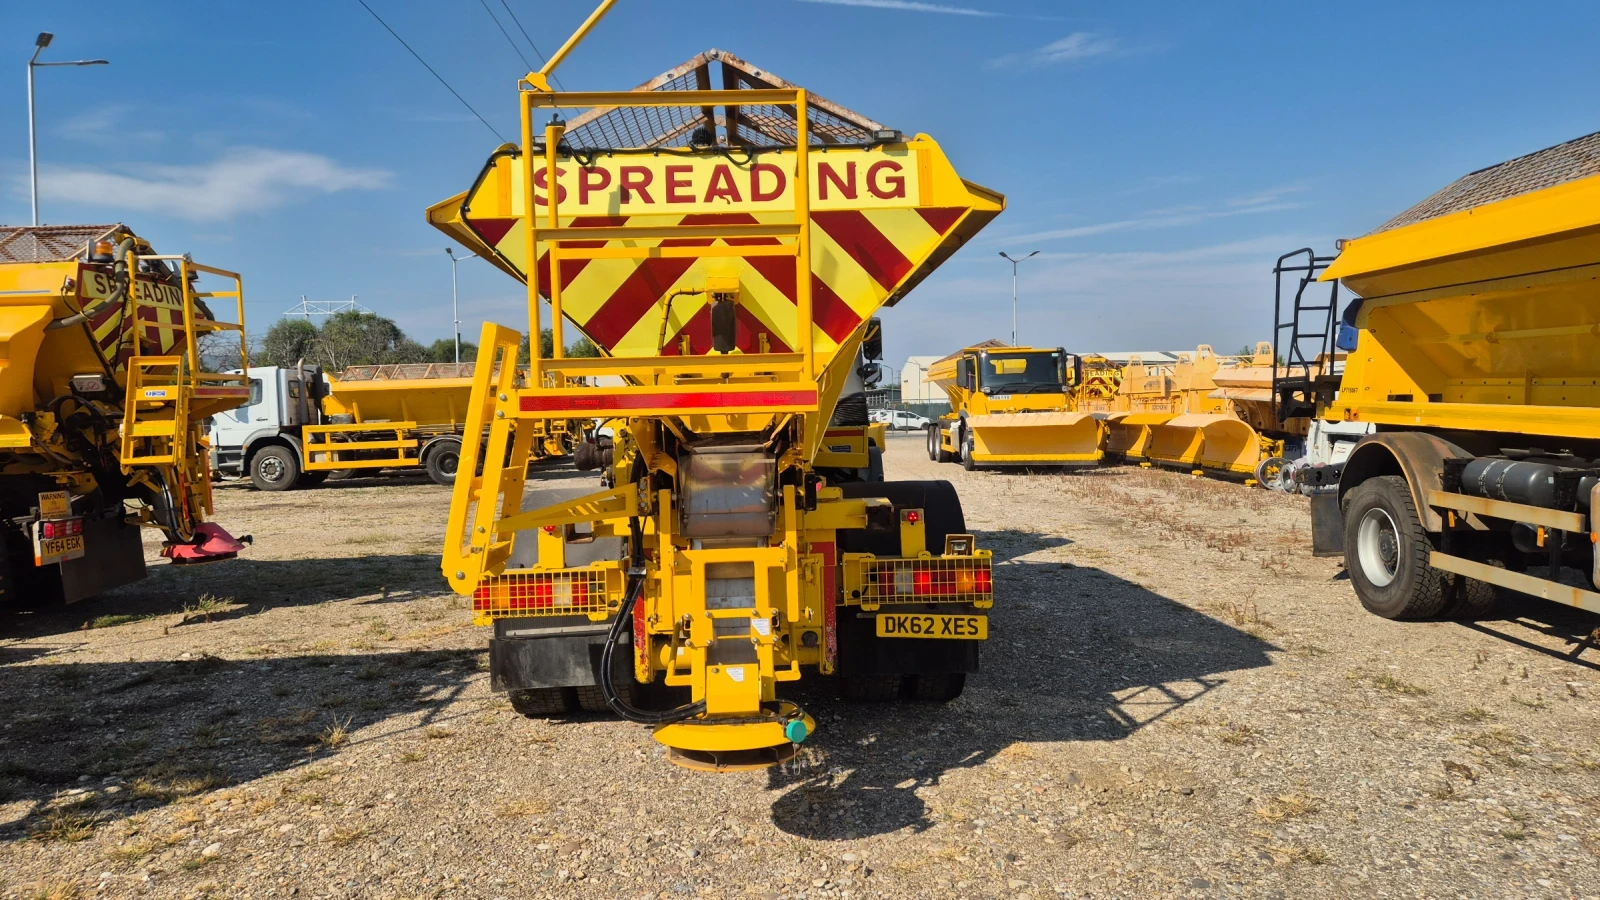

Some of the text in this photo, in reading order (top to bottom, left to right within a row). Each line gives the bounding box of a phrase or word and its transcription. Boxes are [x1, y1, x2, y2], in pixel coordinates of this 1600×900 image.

[534, 160, 906, 206] SPREADNG
[41, 492, 65, 500] WARNING
[45, 537, 81, 554] YF64 EGK
[884, 616, 979, 636] DK62 XES
